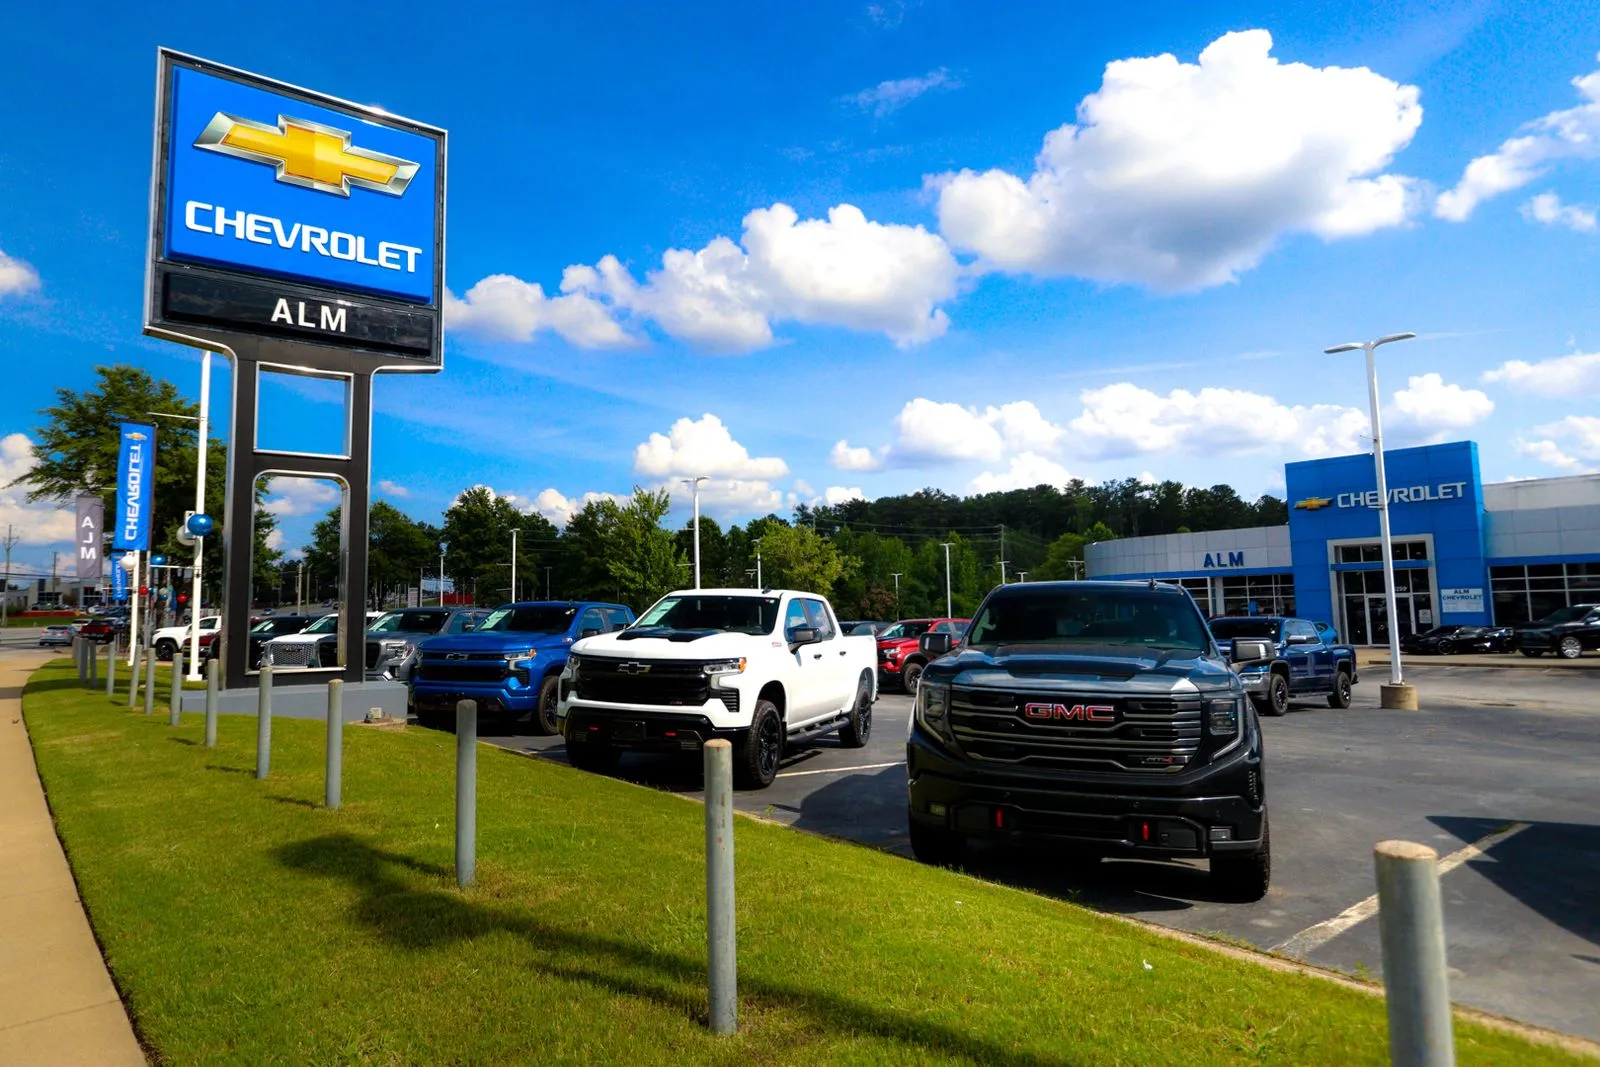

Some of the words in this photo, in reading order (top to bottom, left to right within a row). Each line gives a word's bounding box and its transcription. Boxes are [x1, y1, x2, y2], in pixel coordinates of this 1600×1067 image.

[185, 200, 422, 273] CHEVROLET
[271, 298, 347, 333] ALM
[1203, 551, 1244, 568] ALM
[1025, 702, 1115, 722] GMC
